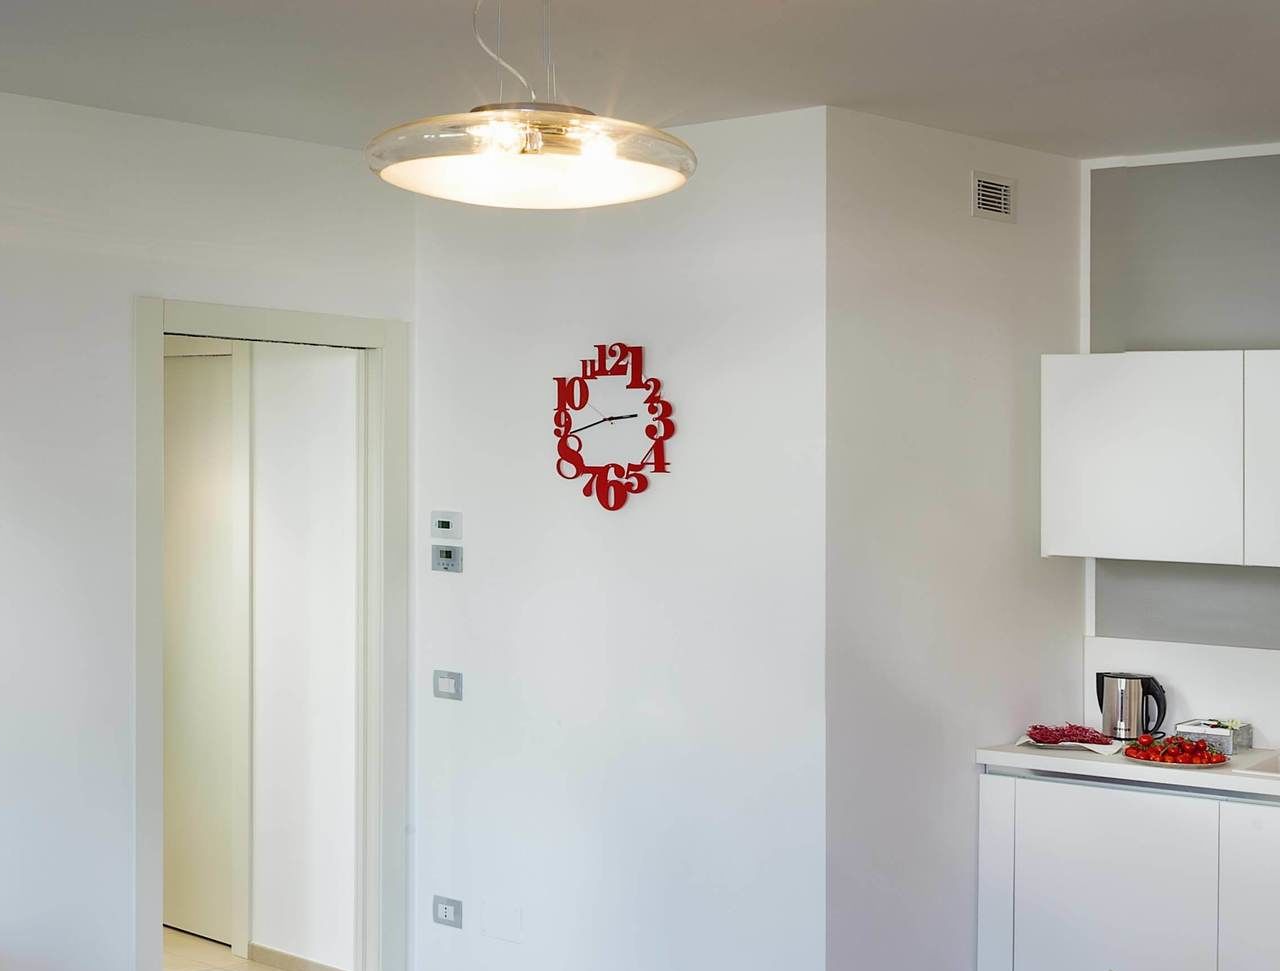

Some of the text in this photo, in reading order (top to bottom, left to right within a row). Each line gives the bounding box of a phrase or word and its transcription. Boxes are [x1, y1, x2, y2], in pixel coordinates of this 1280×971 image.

[580, 360, 597, 379] 11
[594, 343, 629, 376] 12
[626, 346, 647, 388] 1
[553, 377, 589, 411] 10
[644, 378, 661, 404] 2
[554, 410, 572, 438] 9
[645, 400, 675, 440] 3
[557, 434, 584, 479] 8
[641, 436, 671, 473] 4
[582, 466, 606, 497] 7
[596, 463, 627, 511] 6
[624, 463, 648, 493] 5
